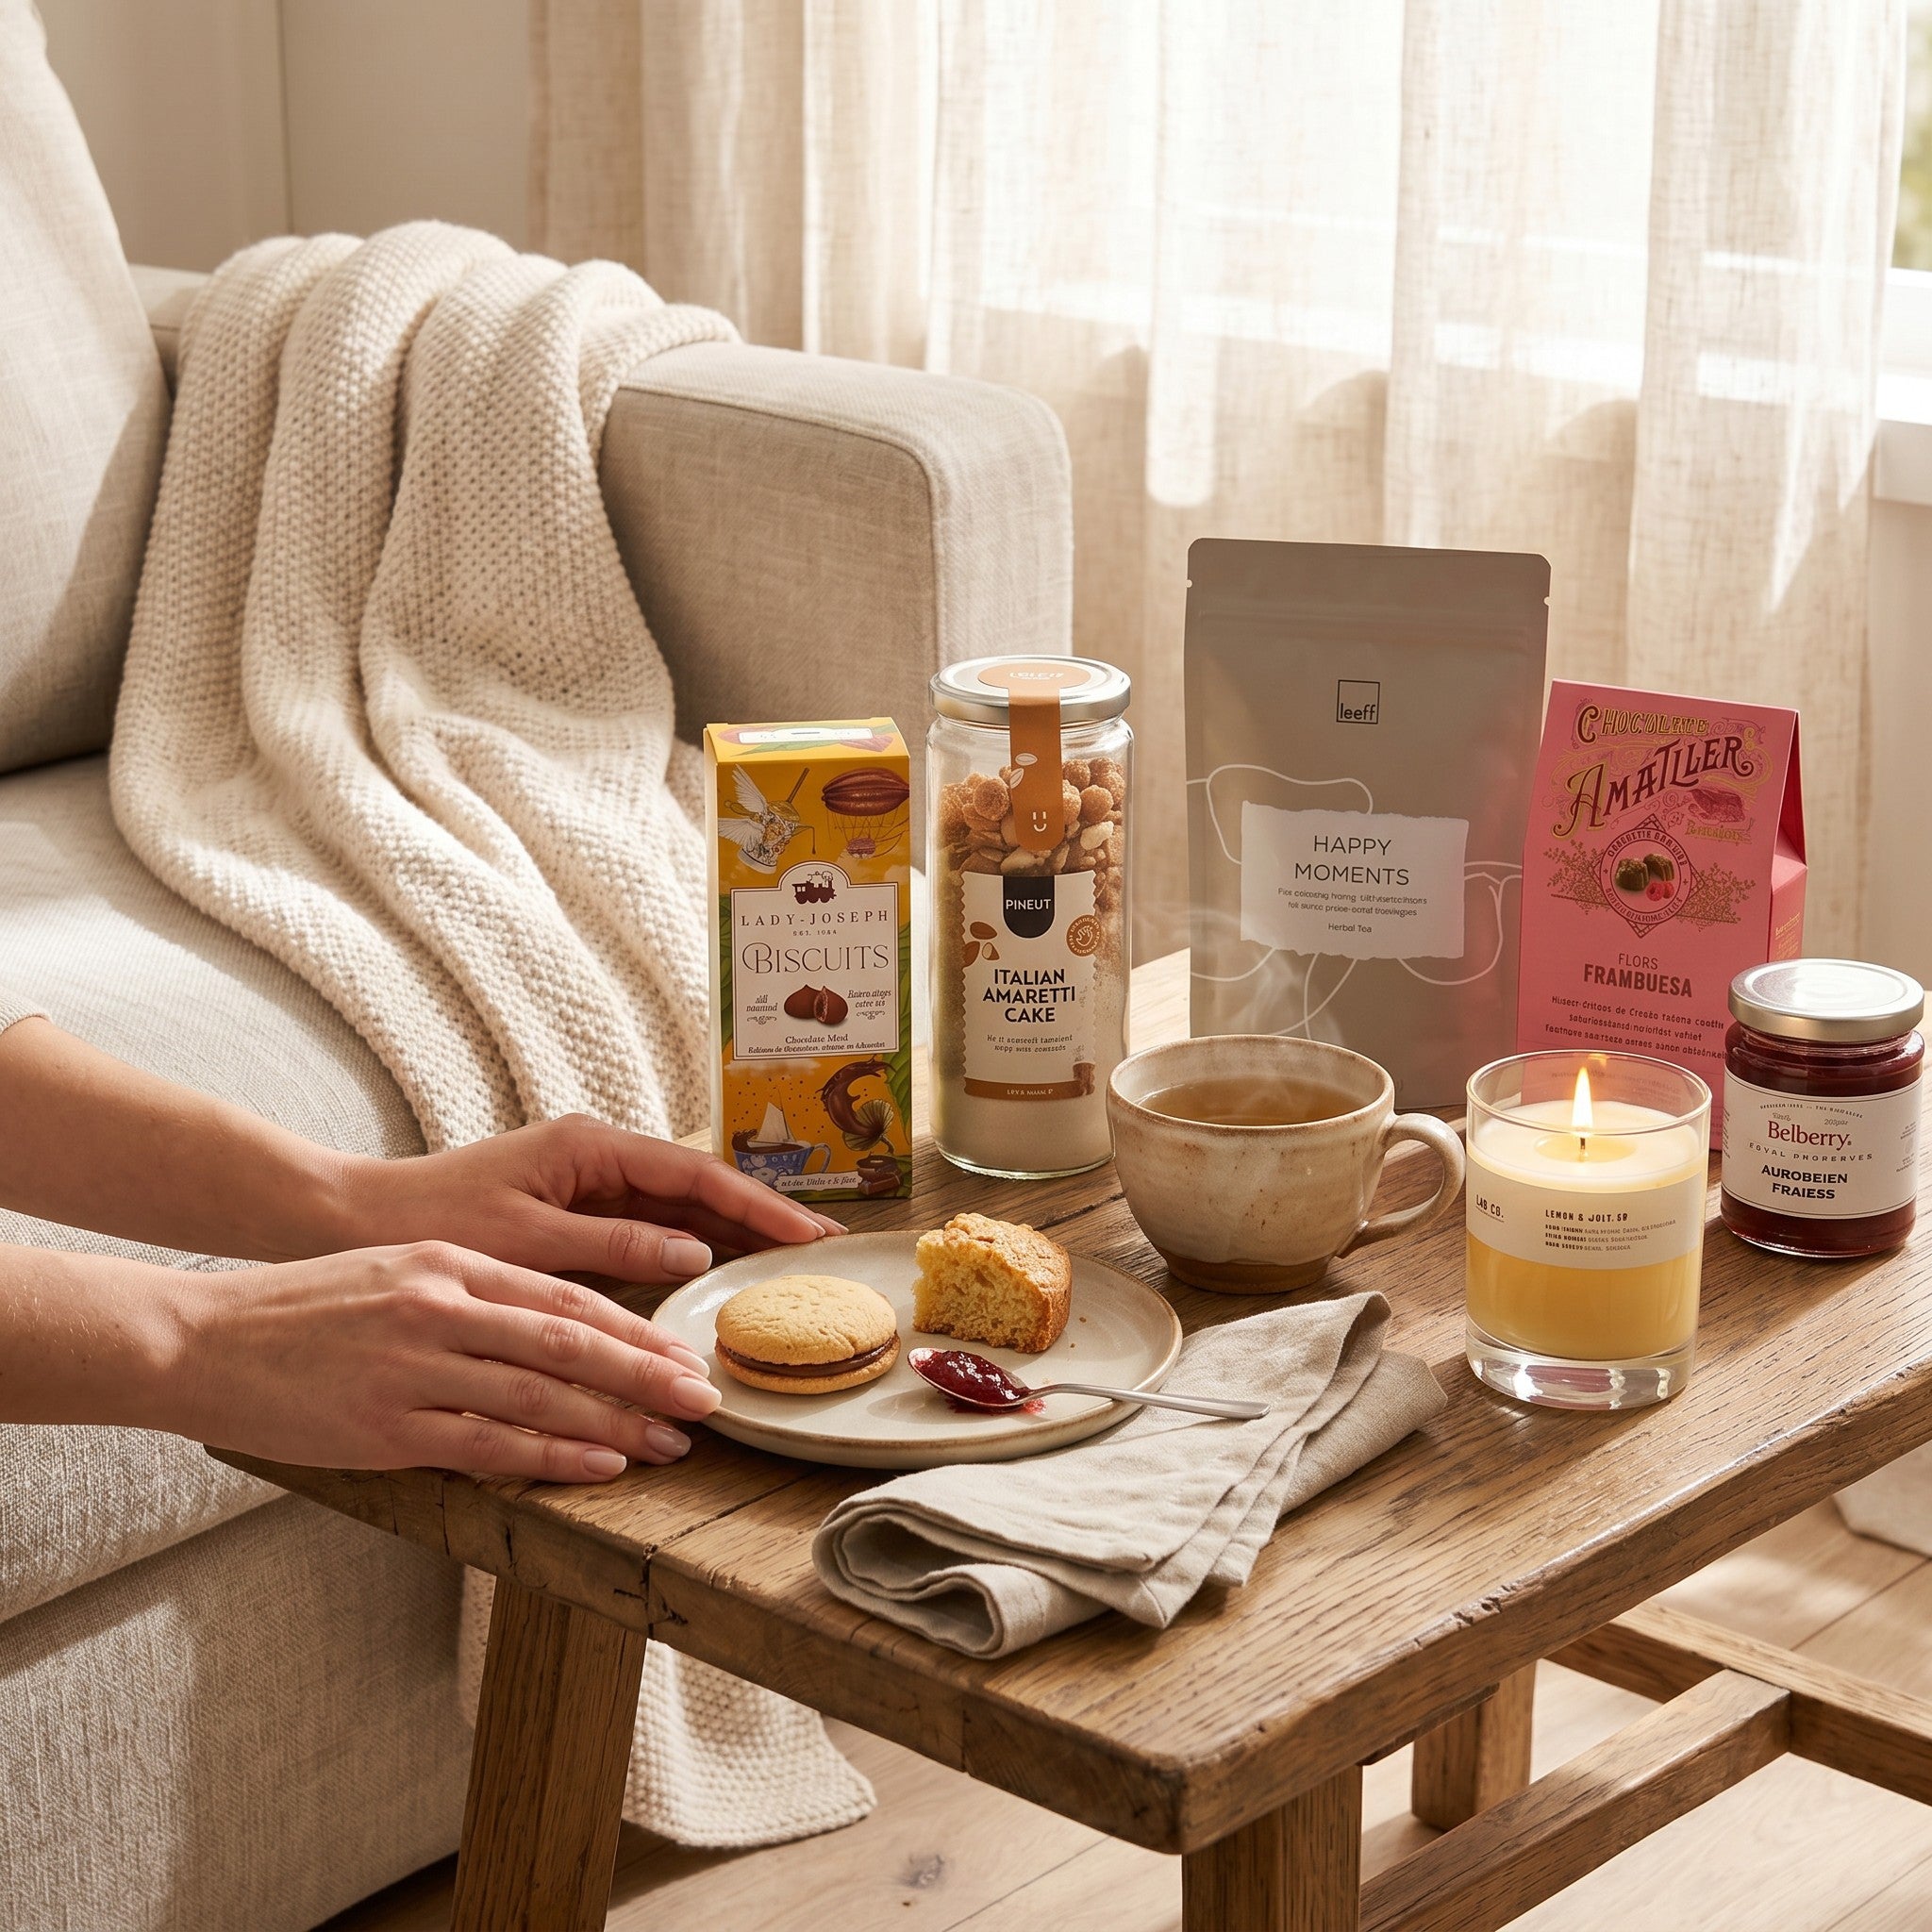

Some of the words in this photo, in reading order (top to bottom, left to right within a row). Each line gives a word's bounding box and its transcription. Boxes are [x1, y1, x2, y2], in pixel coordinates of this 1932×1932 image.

[1340, 703, 1376, 721] leeff
[1313, 835, 1391, 856] HAPPY
[1294, 862, 1409, 886] MOMENTS
[1006, 899, 1051, 910] PINEUT
[741, 910, 888, 926] LADY-JOSEPH
[1327, 923, 1356, 933] Herbal
[741, 942, 889, 974] BISCUITS
[1618, 953, 1658, 970] FLORS
[994, 968, 1065, 986] ITALIAN
[1583, 963, 1692, 998] FRAMBUESA
[982, 986, 1075, 1004] AMARETTI
[1005, 1007, 1056, 1023] CAKE
[1615, 1006, 1626, 1015] de
[1761, 1164, 1848, 1184] AUROBEIEN
[1772, 1182, 1835, 1199] FRAIESS
[1545, 1208, 1574, 1221] LEMON
